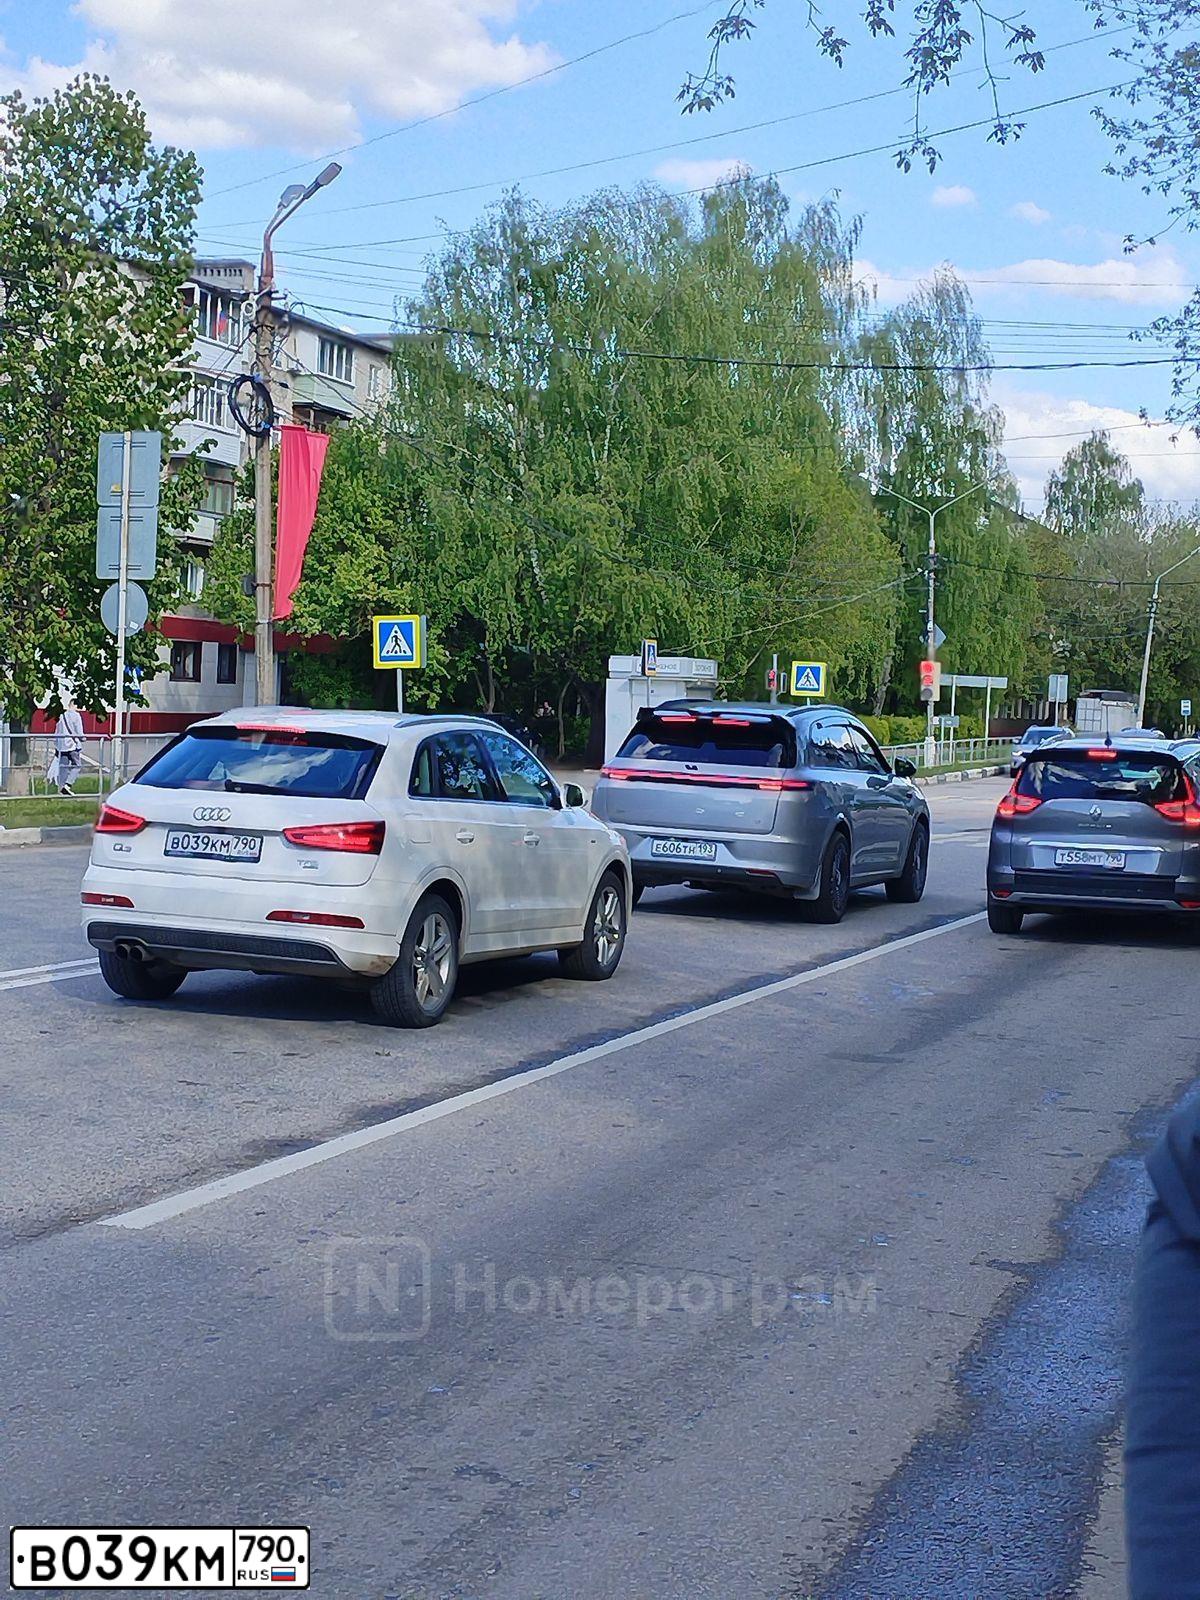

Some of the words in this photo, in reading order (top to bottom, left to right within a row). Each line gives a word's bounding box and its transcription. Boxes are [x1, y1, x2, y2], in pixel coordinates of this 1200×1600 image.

[170, 834, 231, 854] В039КМ
[233, 836, 257, 851] 790
[655, 842, 695, 855] Е606ТН
[698, 842, 713, 855] 193
